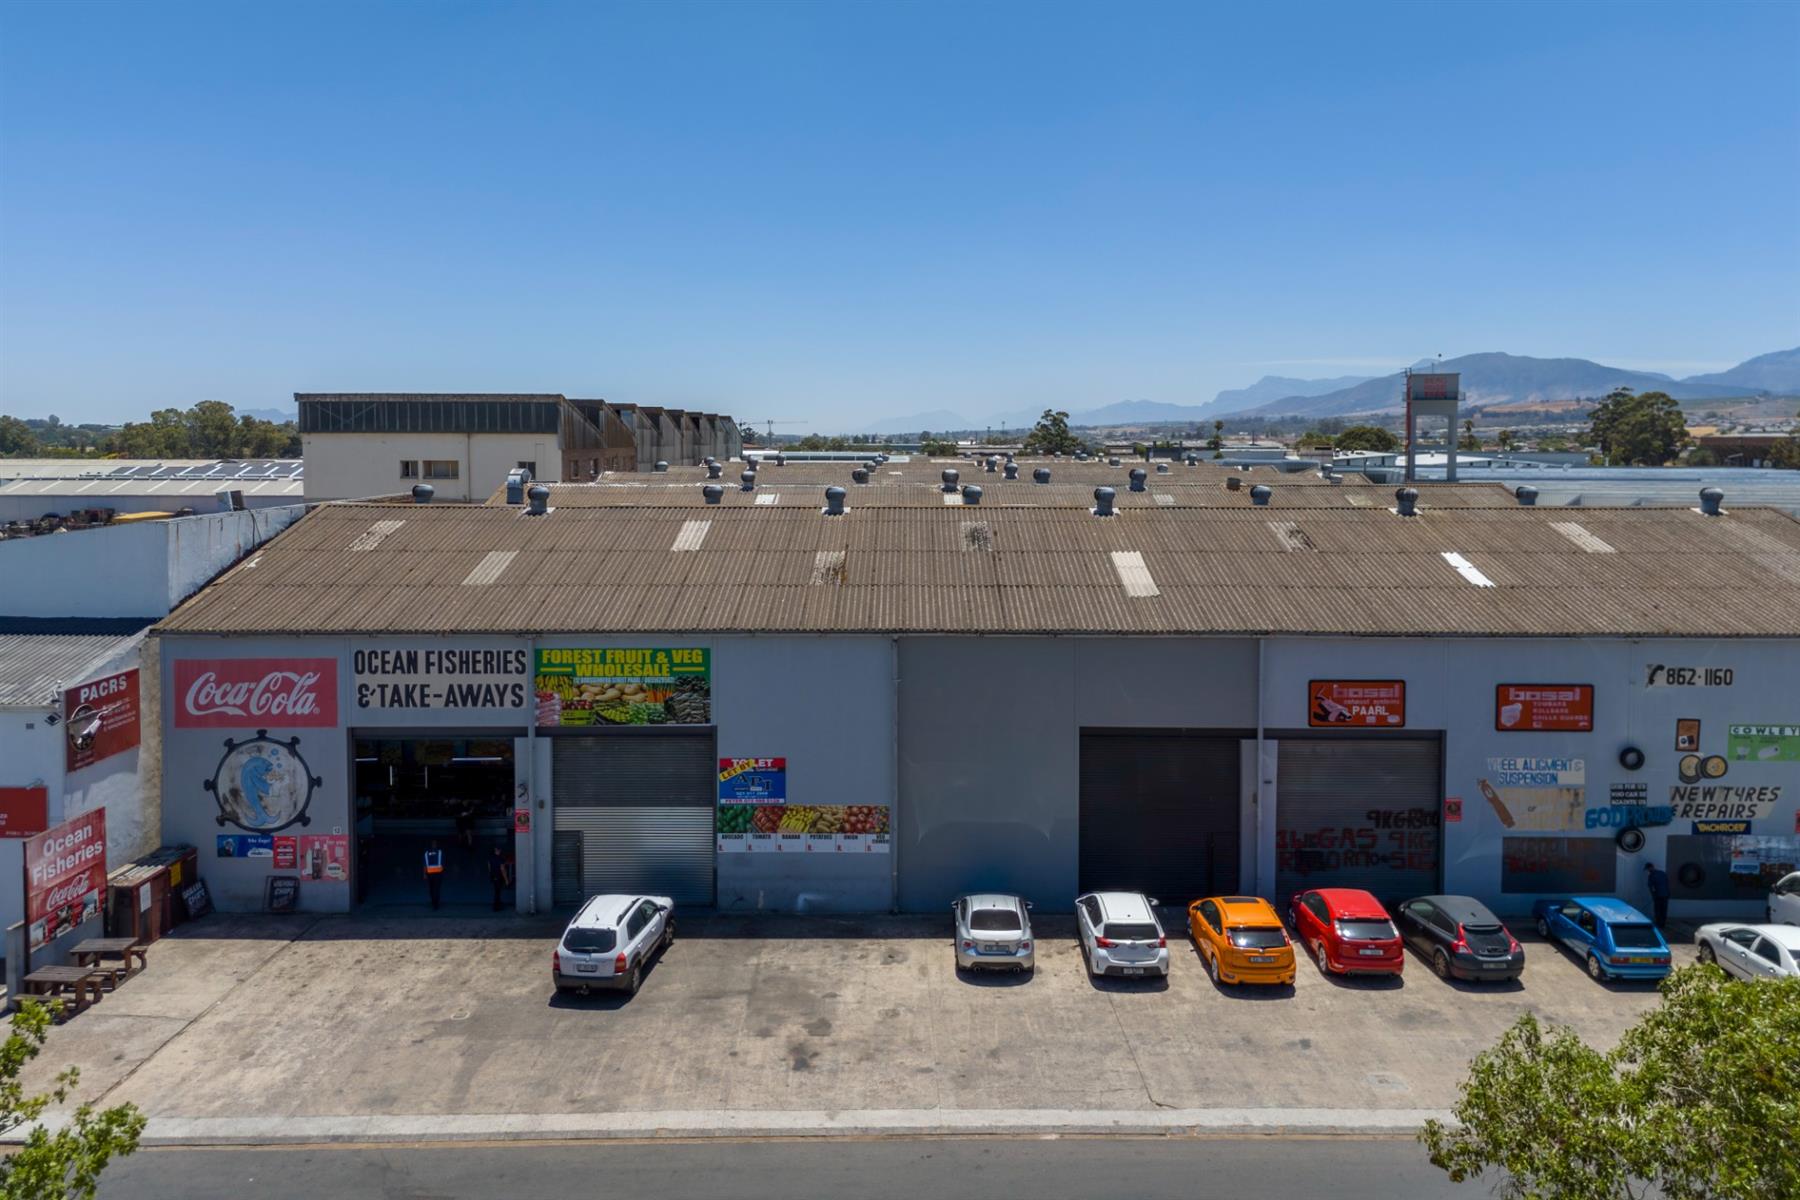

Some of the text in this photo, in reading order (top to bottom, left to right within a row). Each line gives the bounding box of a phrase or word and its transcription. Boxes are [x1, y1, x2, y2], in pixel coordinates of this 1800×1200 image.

[354, 649, 526, 675] OCEAN FISHERIES
[542, 650, 703, 664] FOREST FRUIT & VEG
[576, 664, 671, 677] WHOLESALE
[81, 675, 127, 703] PACRS
[185, 671, 320, 716] Coca-Cola
[1509, 688, 1580, 701] bosal
[1352, 705, 1390, 716] PAARL
[1733, 727, 1797, 736] COWLEY
[1498, 772, 1558, 785] SUSPENSION
[1671, 786, 1781, 801] NEW TYRES
[1681, 804, 1758, 818] REPAIRS
[43, 824, 93, 857] Ocean
[32, 840, 103, 886] Fisheries
